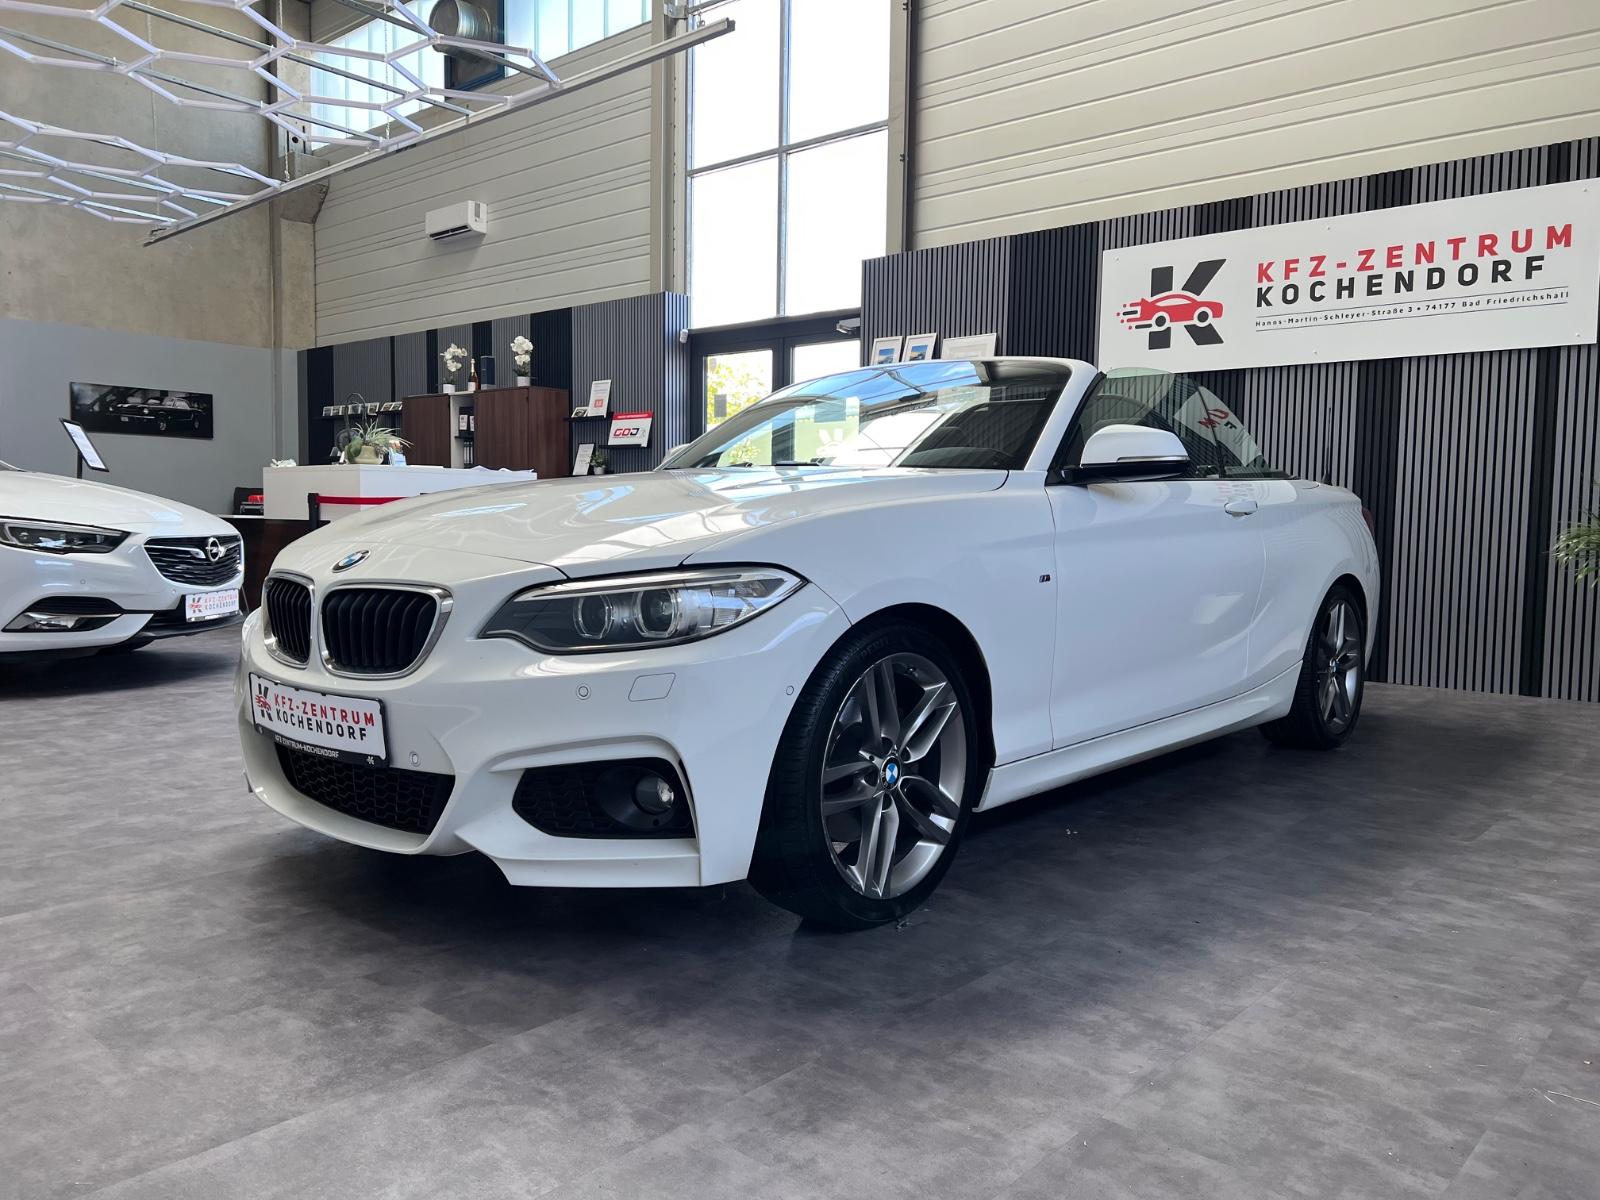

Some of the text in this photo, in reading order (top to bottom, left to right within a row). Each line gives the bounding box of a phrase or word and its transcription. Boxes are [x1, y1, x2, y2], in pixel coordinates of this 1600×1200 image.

[1257, 223, 1573, 284] KFZ-ZENTRUM
[1256, 255, 1545, 308] KOCHENDORF
[1425, 302, 1456, 311] 74177
[1462, 300, 1481, 308] Bad
[1486, 291, 1569, 305] Friedrichshall
[273, 693, 375, 727] KFZ-ZENTRUM
[276, 708, 368, 741] KOCHENDORF
